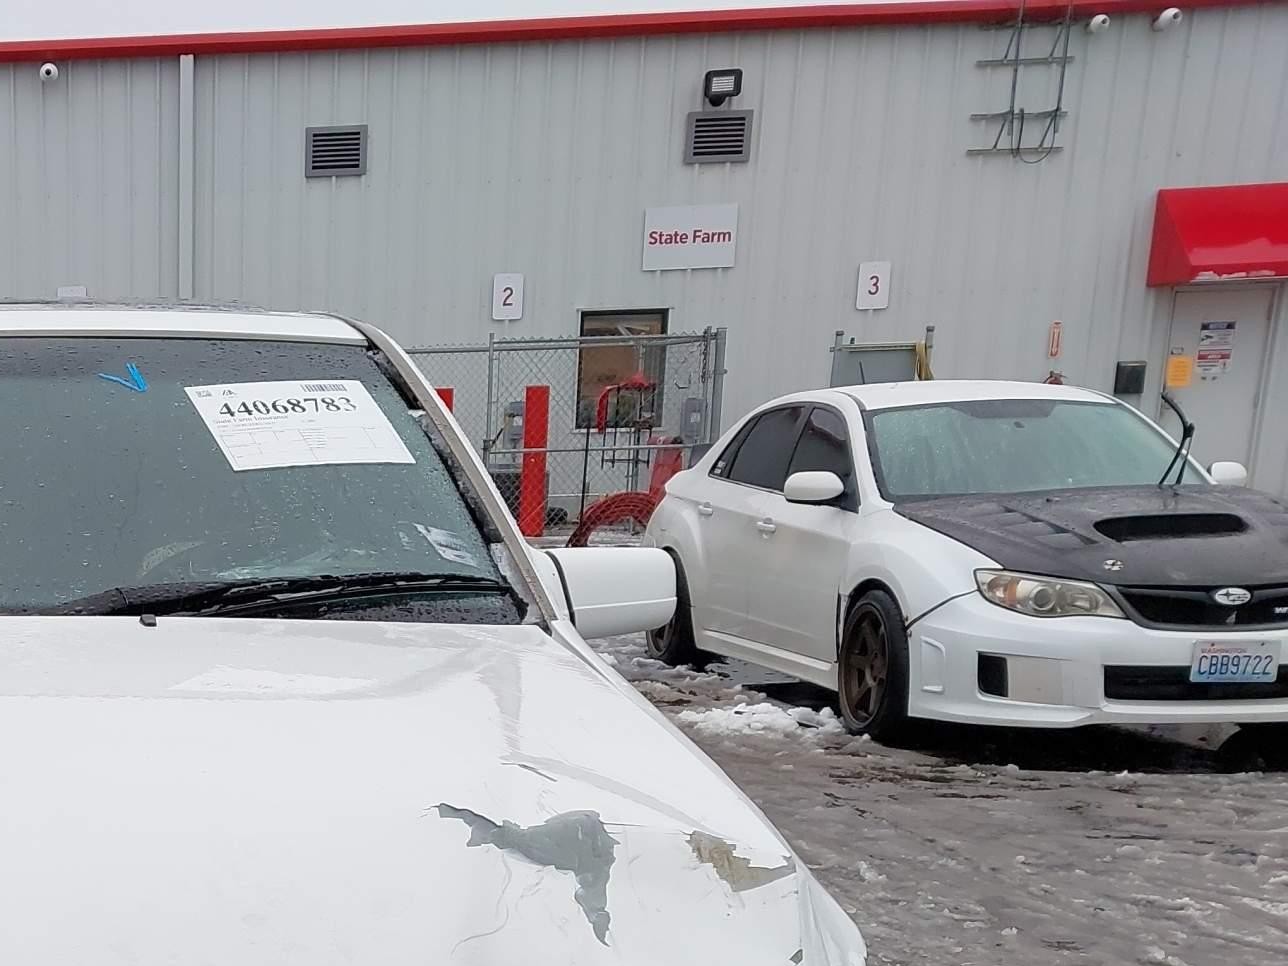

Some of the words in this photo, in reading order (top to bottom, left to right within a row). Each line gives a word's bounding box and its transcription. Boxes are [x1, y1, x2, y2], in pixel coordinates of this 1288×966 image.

[648, 230, 689, 245] State
[692, 229, 732, 244] Farm
[867, 275, 880, 296] 3
[502, 286, 514, 307] 2
[219, 397, 358, 418] 44068783
[1197, 654, 1274, 676] CBB9722
